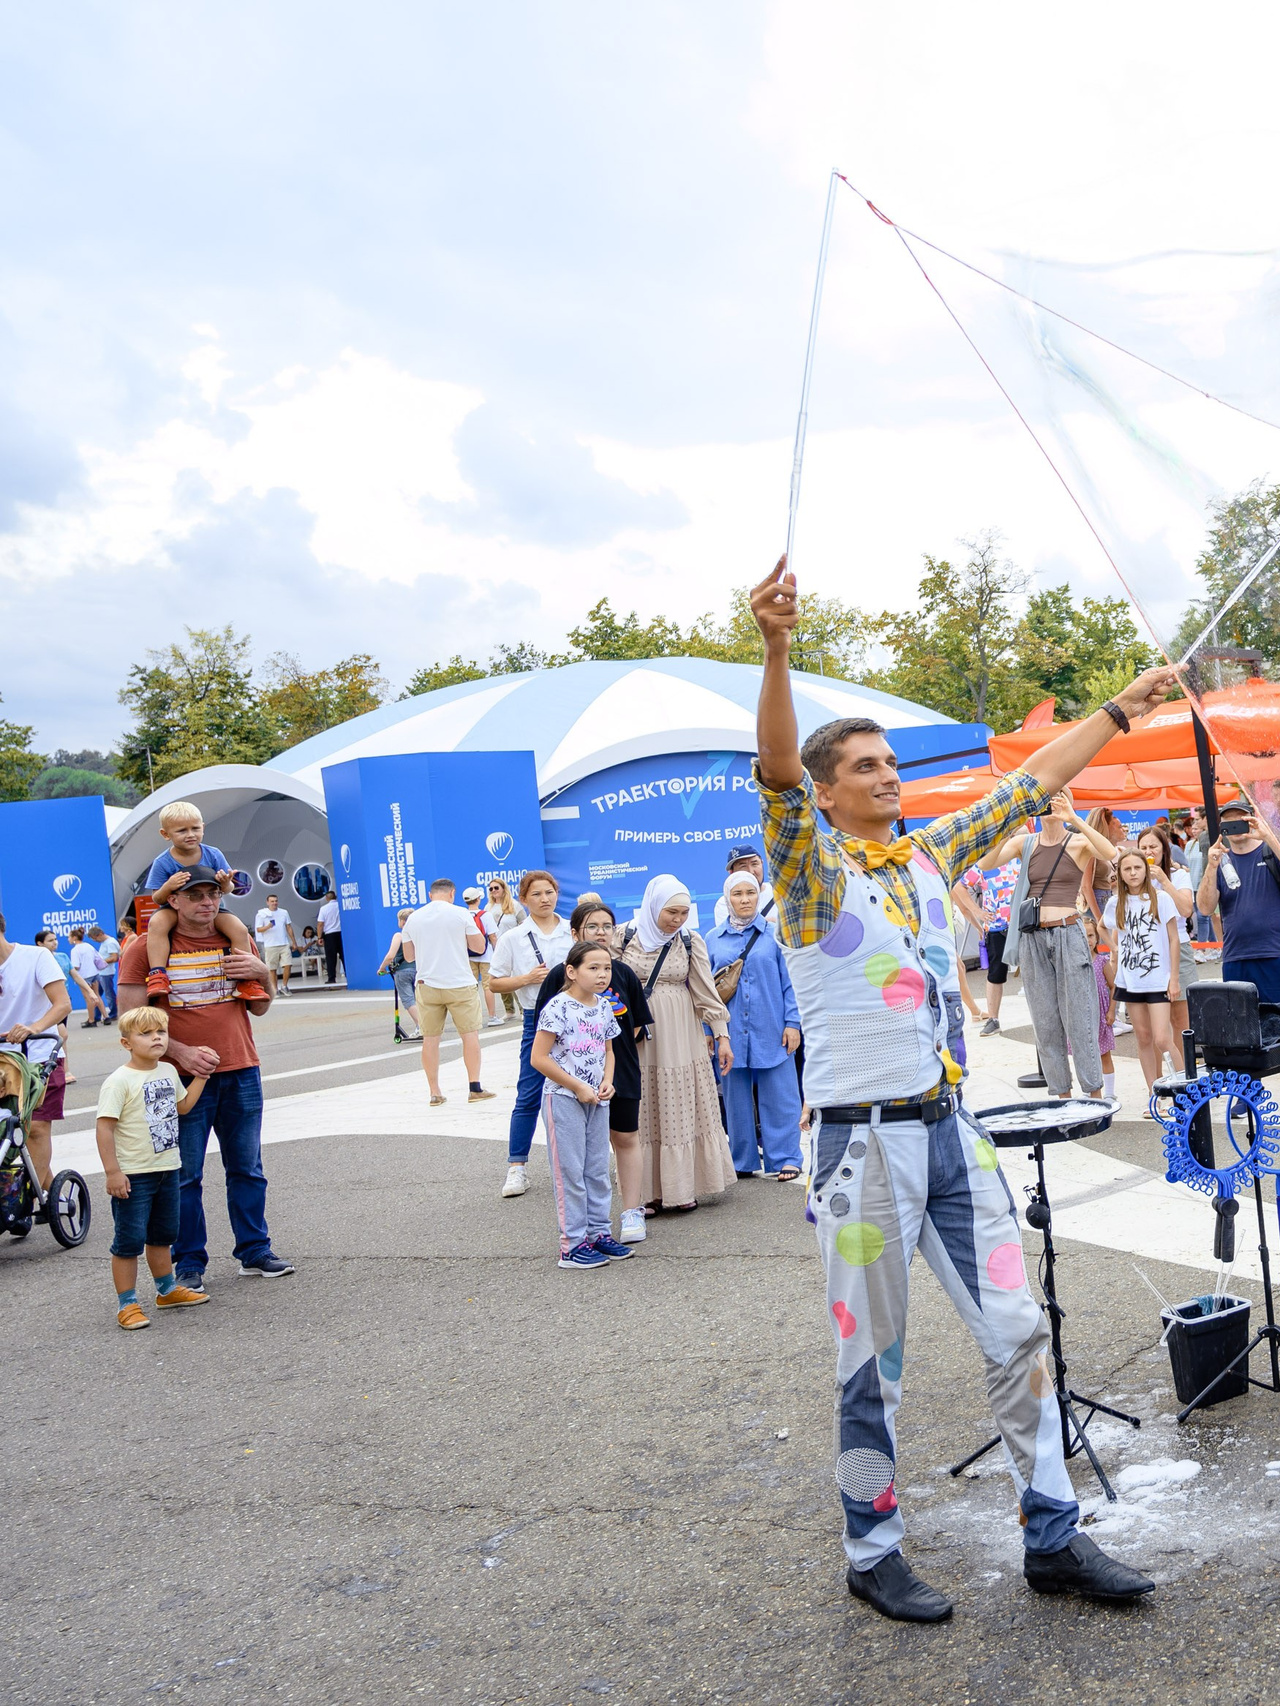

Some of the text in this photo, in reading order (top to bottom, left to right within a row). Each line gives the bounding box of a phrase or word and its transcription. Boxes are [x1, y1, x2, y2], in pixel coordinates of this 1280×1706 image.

[591, 775, 725, 813] ТРАЕКТОРИЯ
[614, 829, 680, 843] ПРИМЕРЬ
[683, 829, 722, 843] СВОЕ
[390, 802, 409, 906] УРБАНИСТИЧЕСКИЙ
[384, 834, 400, 907] МОСКОВСКИЙ
[589, 862, 630, 871] МОСКОВСКИЙ
[589, 866, 648, 877] УРБАНИСТИЧЕСКИЙ
[407, 866, 418, 905] ФОРУМ
[42, 908, 97, 926] СДЕЛАНО
[174, 946, 218, 955] MOLITION
[1121, 933, 1153, 953] SOME
[1121, 949, 1160, 979] NOISE
